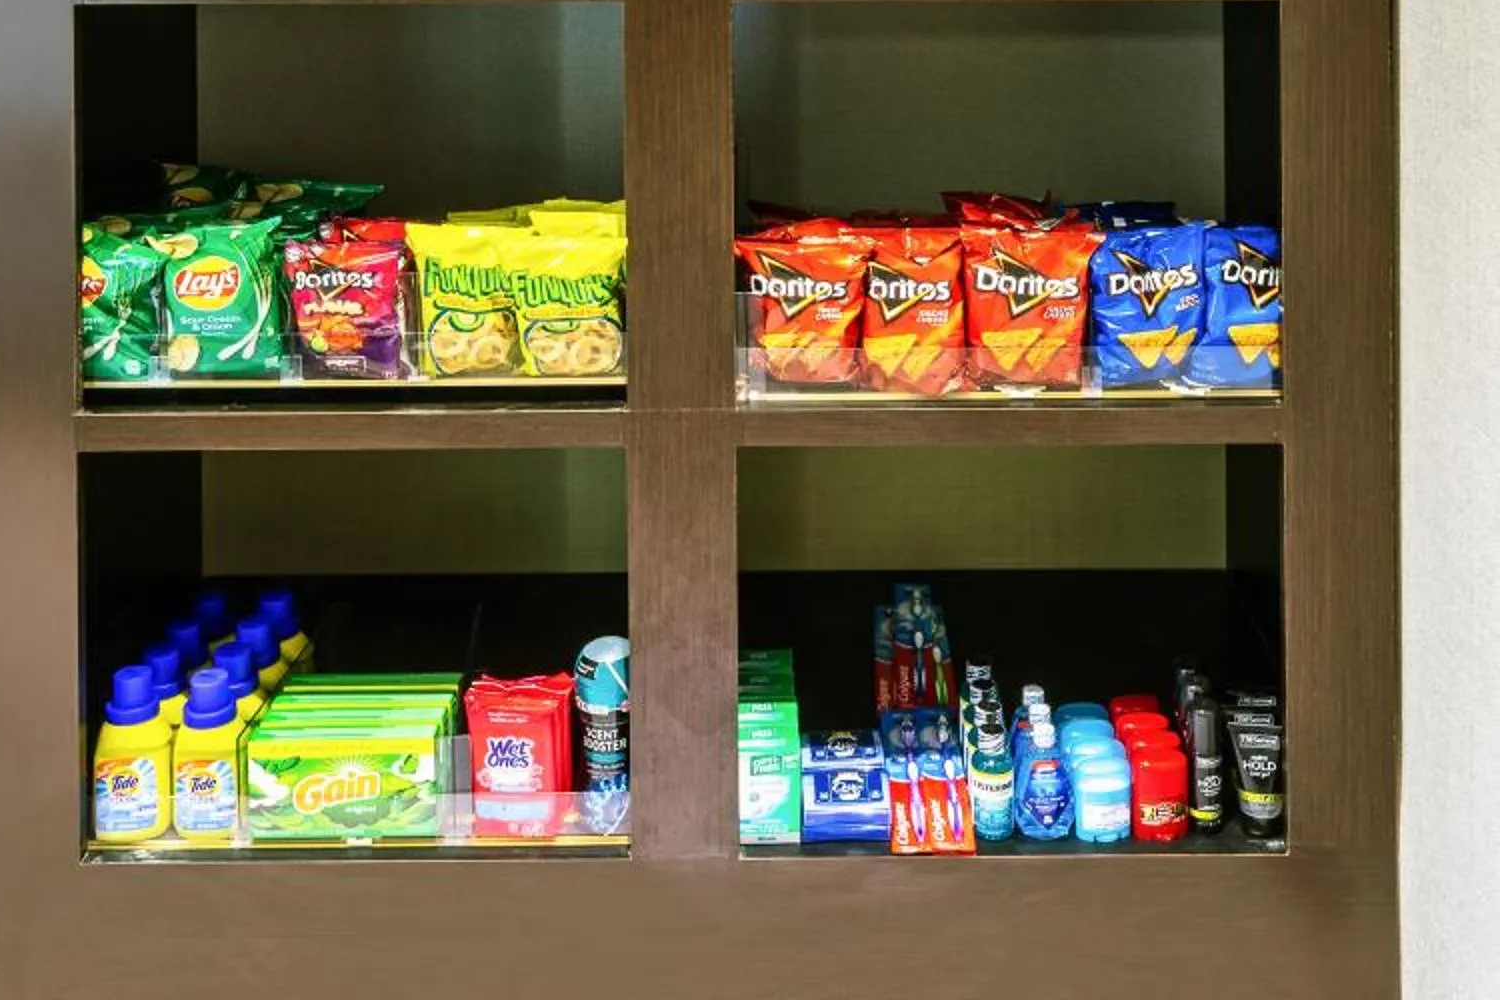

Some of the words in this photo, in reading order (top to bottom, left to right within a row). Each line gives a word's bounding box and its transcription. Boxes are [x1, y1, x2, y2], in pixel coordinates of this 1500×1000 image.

[975, 265, 1080, 299] Doritos
[1109, 264, 1199, 295] Doritos
[1222, 259, 1279, 286] Dori
[177, 270, 237, 299] Lay's
[750, 274, 847, 300] Doritos
[869, 279, 950, 299] oritos
[490, 740, 530, 756] Wet
[488, 753, 529, 768] Ones
[1243, 761, 1277, 771] HOLD
[111, 775, 139, 792] Tide
[191, 776, 217, 792] Tide
[295, 771, 381, 814] Gain
